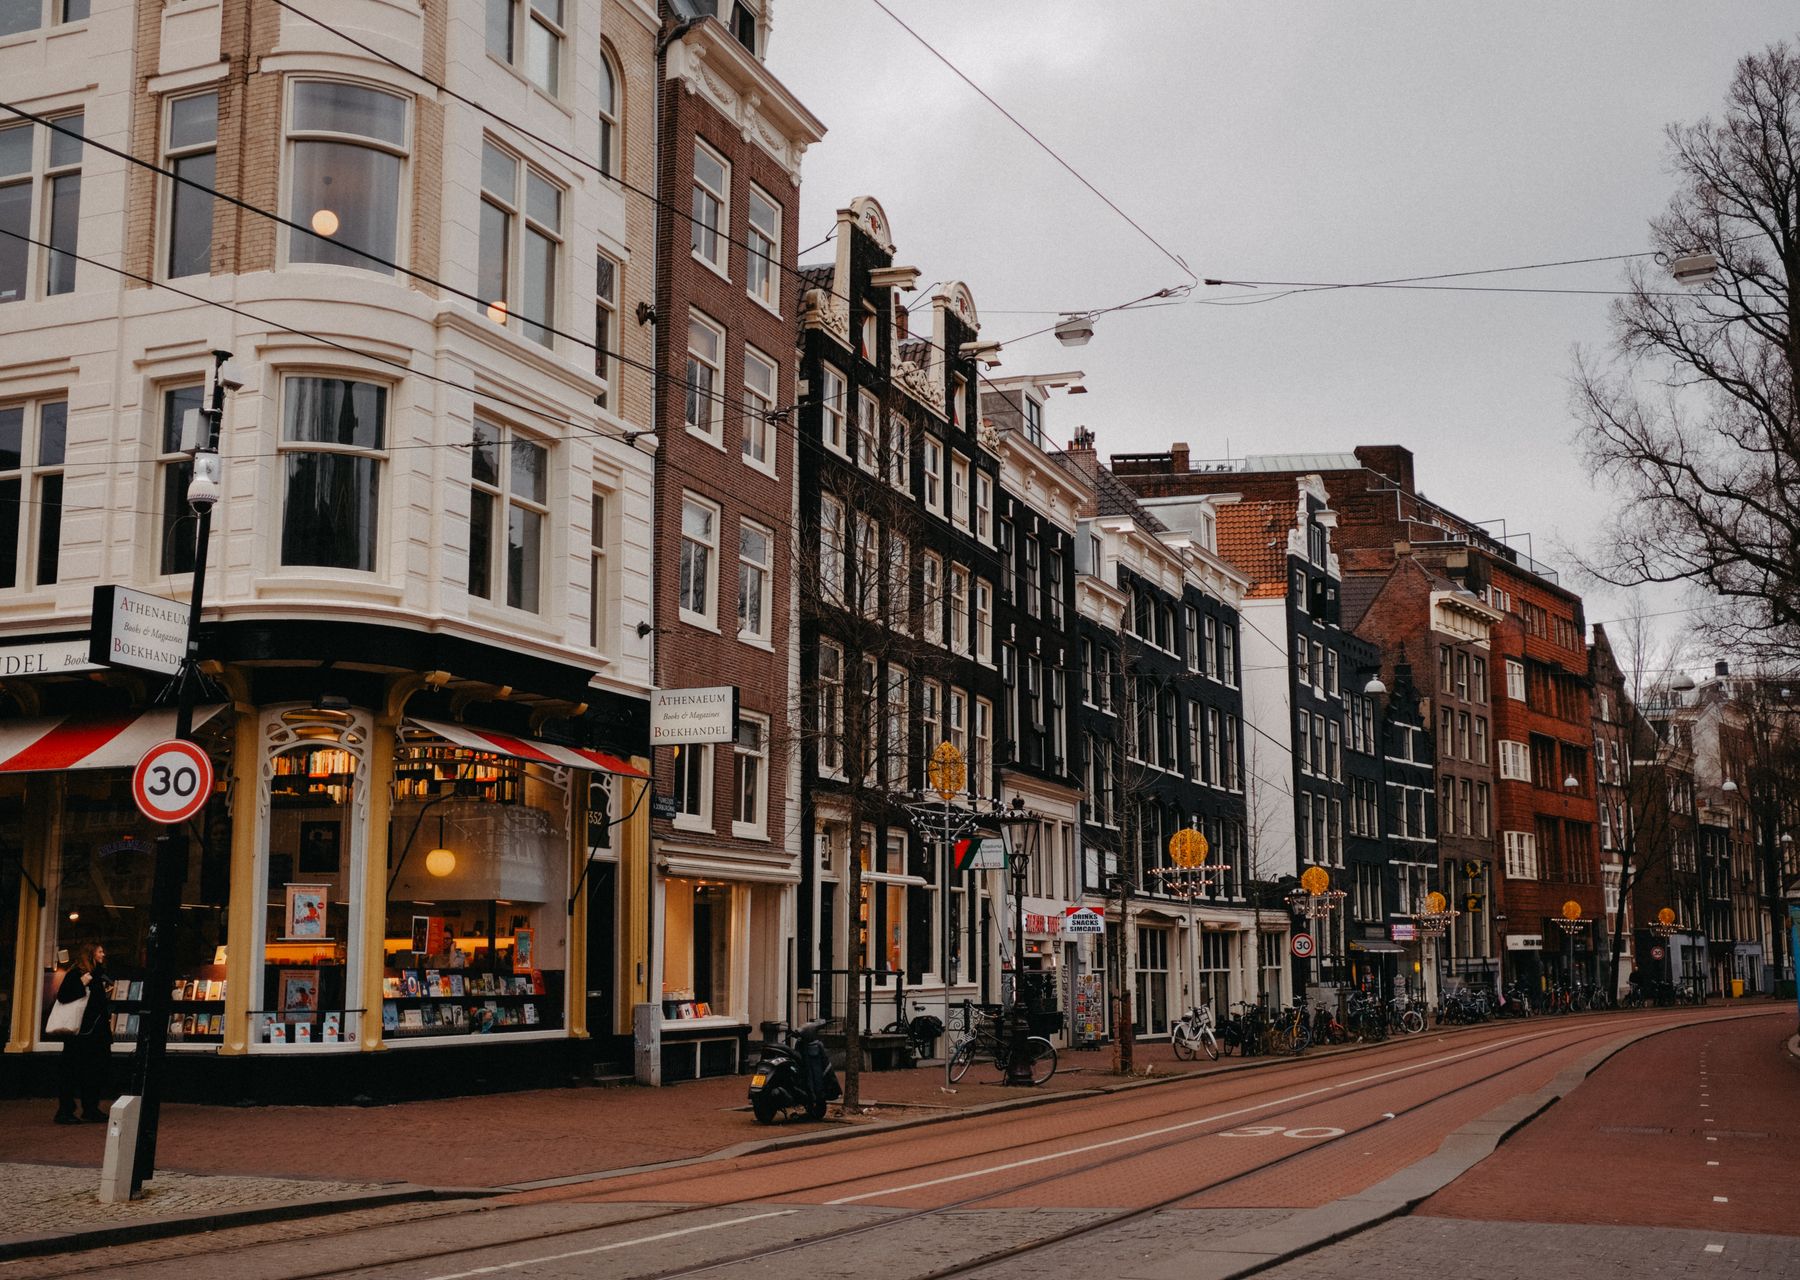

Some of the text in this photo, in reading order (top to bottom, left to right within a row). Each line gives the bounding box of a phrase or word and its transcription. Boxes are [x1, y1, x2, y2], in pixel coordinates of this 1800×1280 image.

[124, 621, 183, 644] Books & Magazines
[114, 637, 183, 666] BOEKHANDE
[0, 653, 48, 674] DEL
[658, 694, 726, 706] ATHENAEUM
[663, 711, 720, 721] Books & Magazines
[654, 725, 728, 738] BOEKHANDEL
[148, 765, 197, 797] 30
[588, 811, 602, 825] 352
[1296, 940, 1310, 950] 30
[1218, 1126, 1346, 1138] 30
